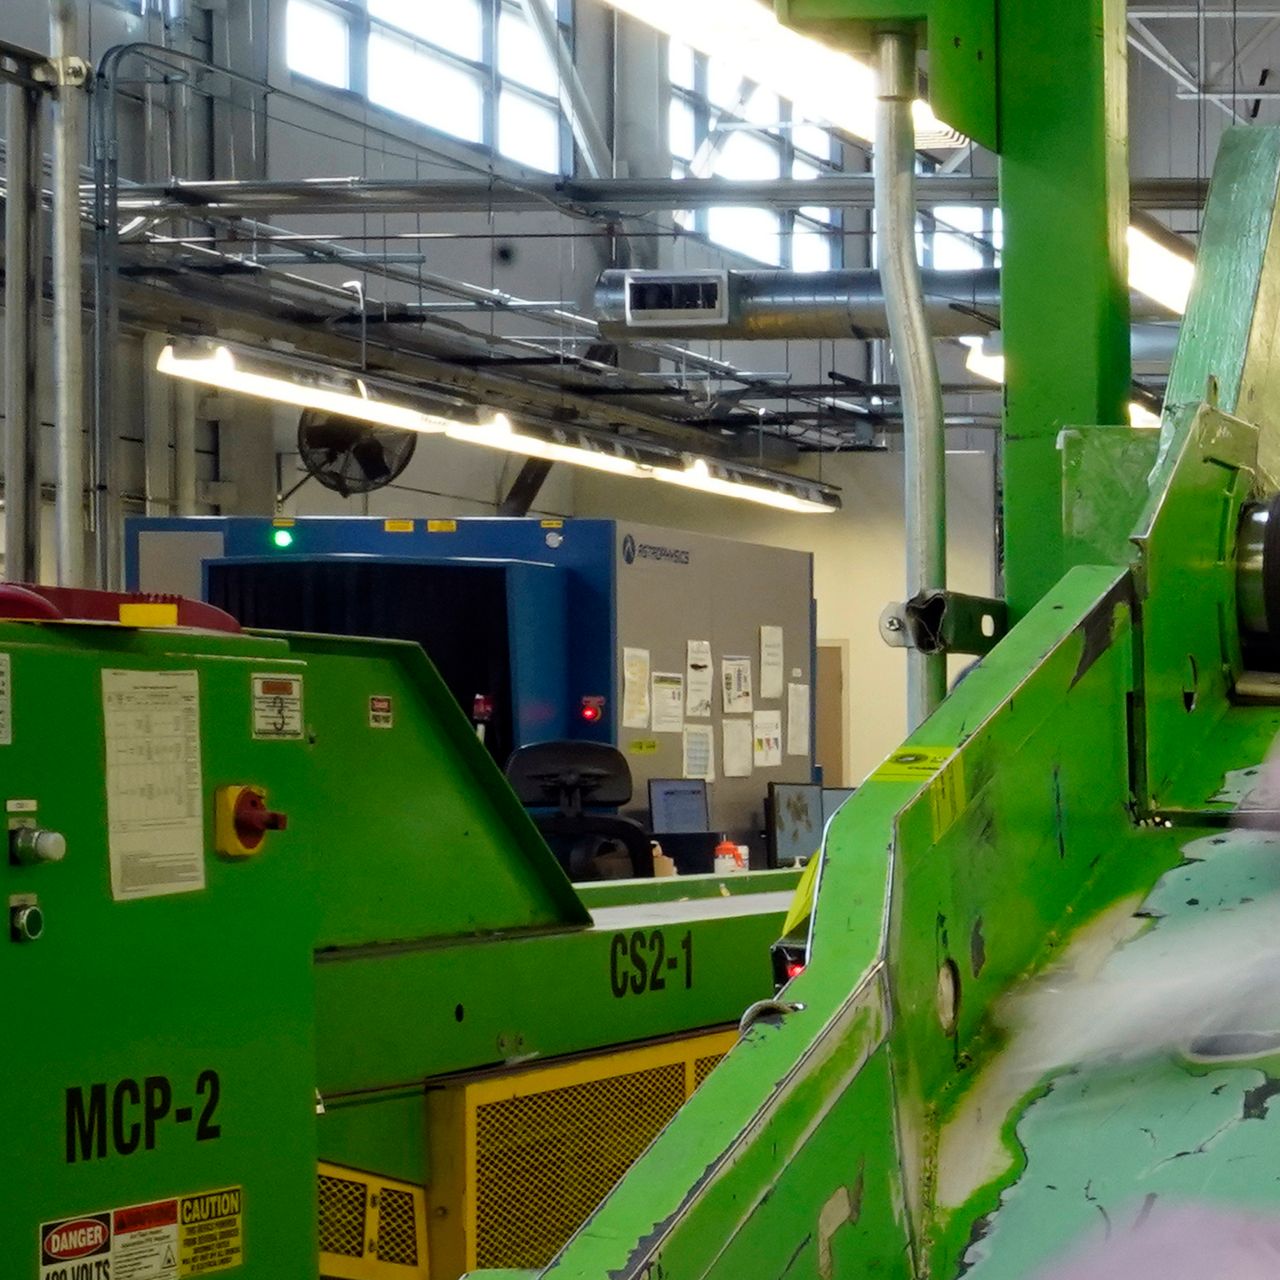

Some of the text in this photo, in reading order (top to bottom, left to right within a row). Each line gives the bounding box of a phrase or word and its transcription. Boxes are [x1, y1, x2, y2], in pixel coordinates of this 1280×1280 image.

[610, 929, 692, 998] CS2-1
[65, 1069, 221, 1163] MCP-2
[183, 1191, 240, 1223] CAUTION
[51, 1225, 103, 1254] DANGER
